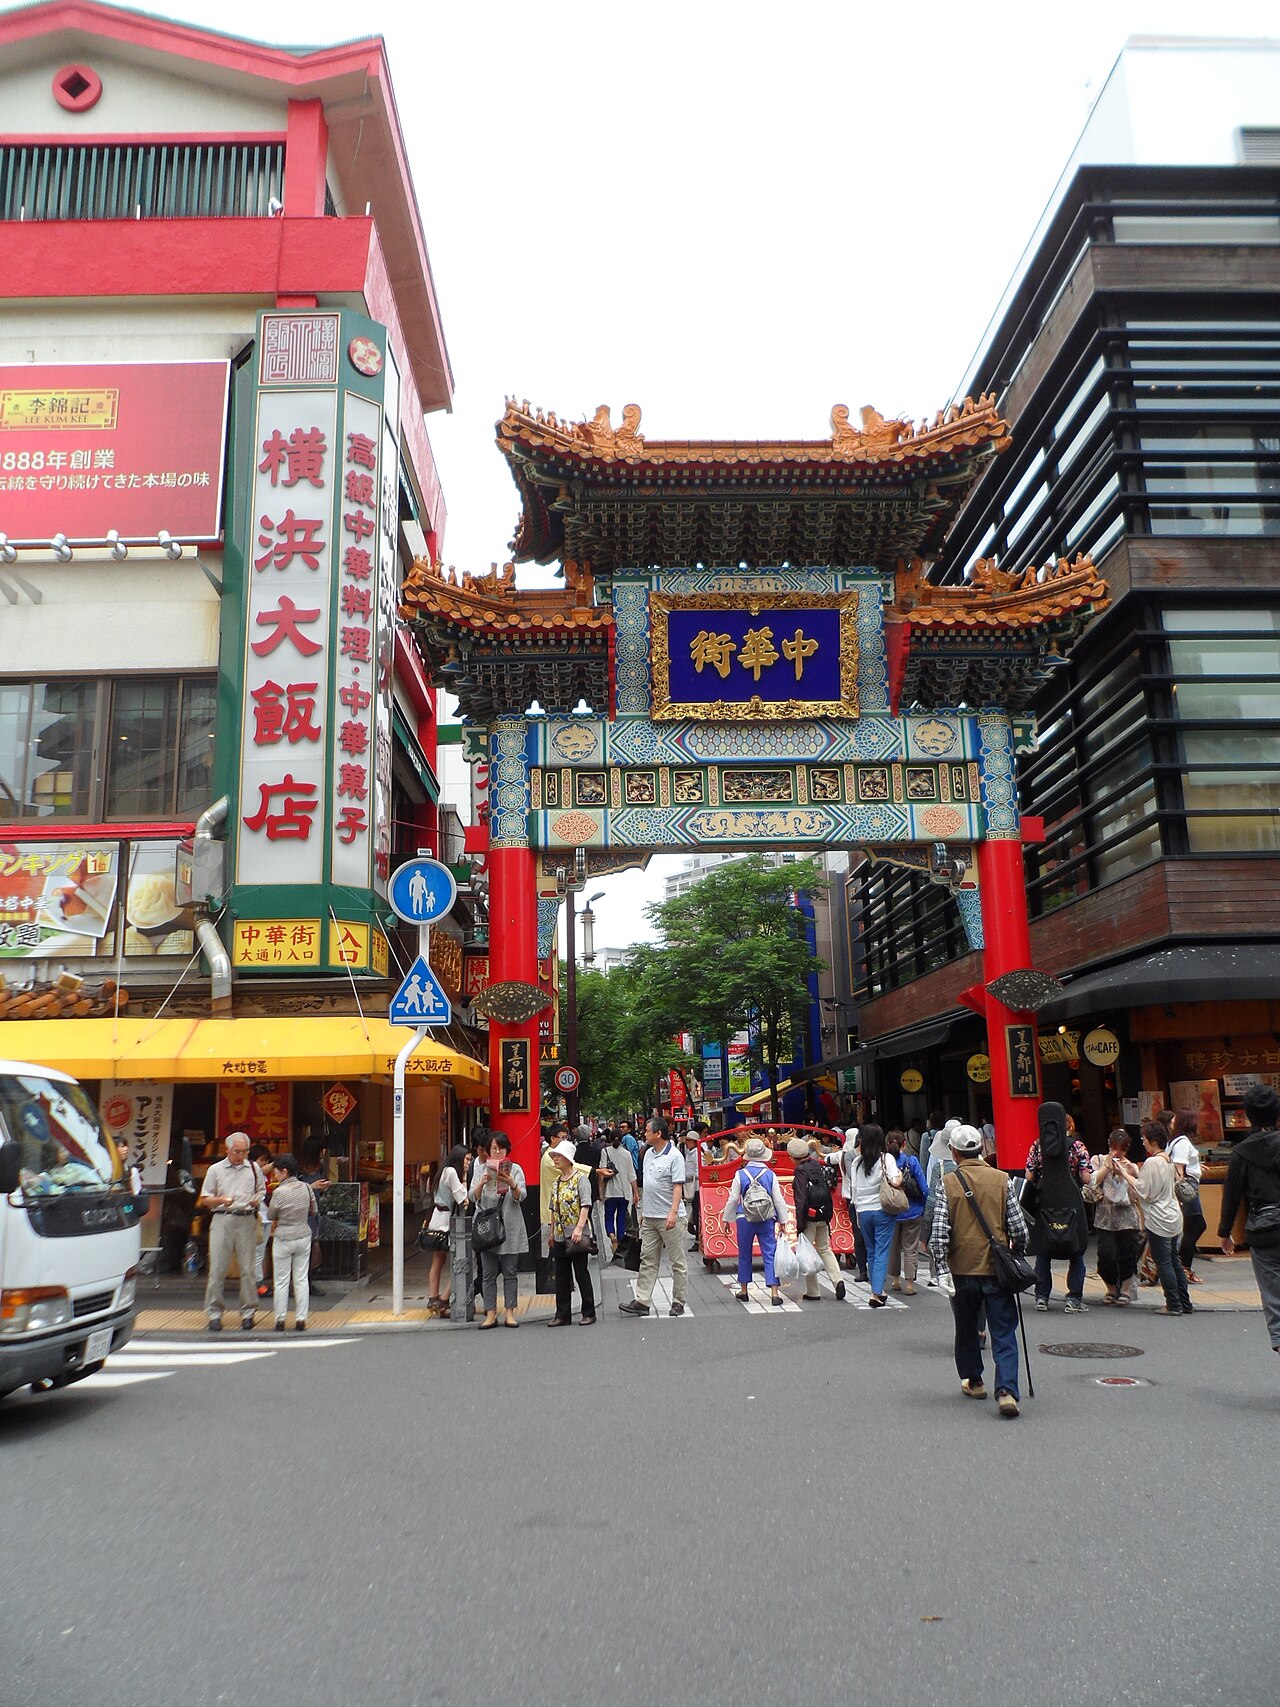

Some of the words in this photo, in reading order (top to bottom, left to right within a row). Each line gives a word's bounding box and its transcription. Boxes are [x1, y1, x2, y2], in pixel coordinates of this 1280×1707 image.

[28, 397, 90, 414] 李錦記
[25, 416, 40, 424] LEE
[71, 415, 88, 423] KEE
[0, 449, 115, 470] 888年創業
[244, 426, 327, 842] 横浜大飯店
[240, 925, 316, 946] 中華街
[337, 927, 362, 963] 入口
[239, 948, 314, 962] 大通り入口
[1085, 1043, 1098, 1053] The
[1097, 1041, 1118, 1053] CAFE
[223, 1060, 267, 1074] 大粒甘栗
[560, 1073, 575, 1085] 30
